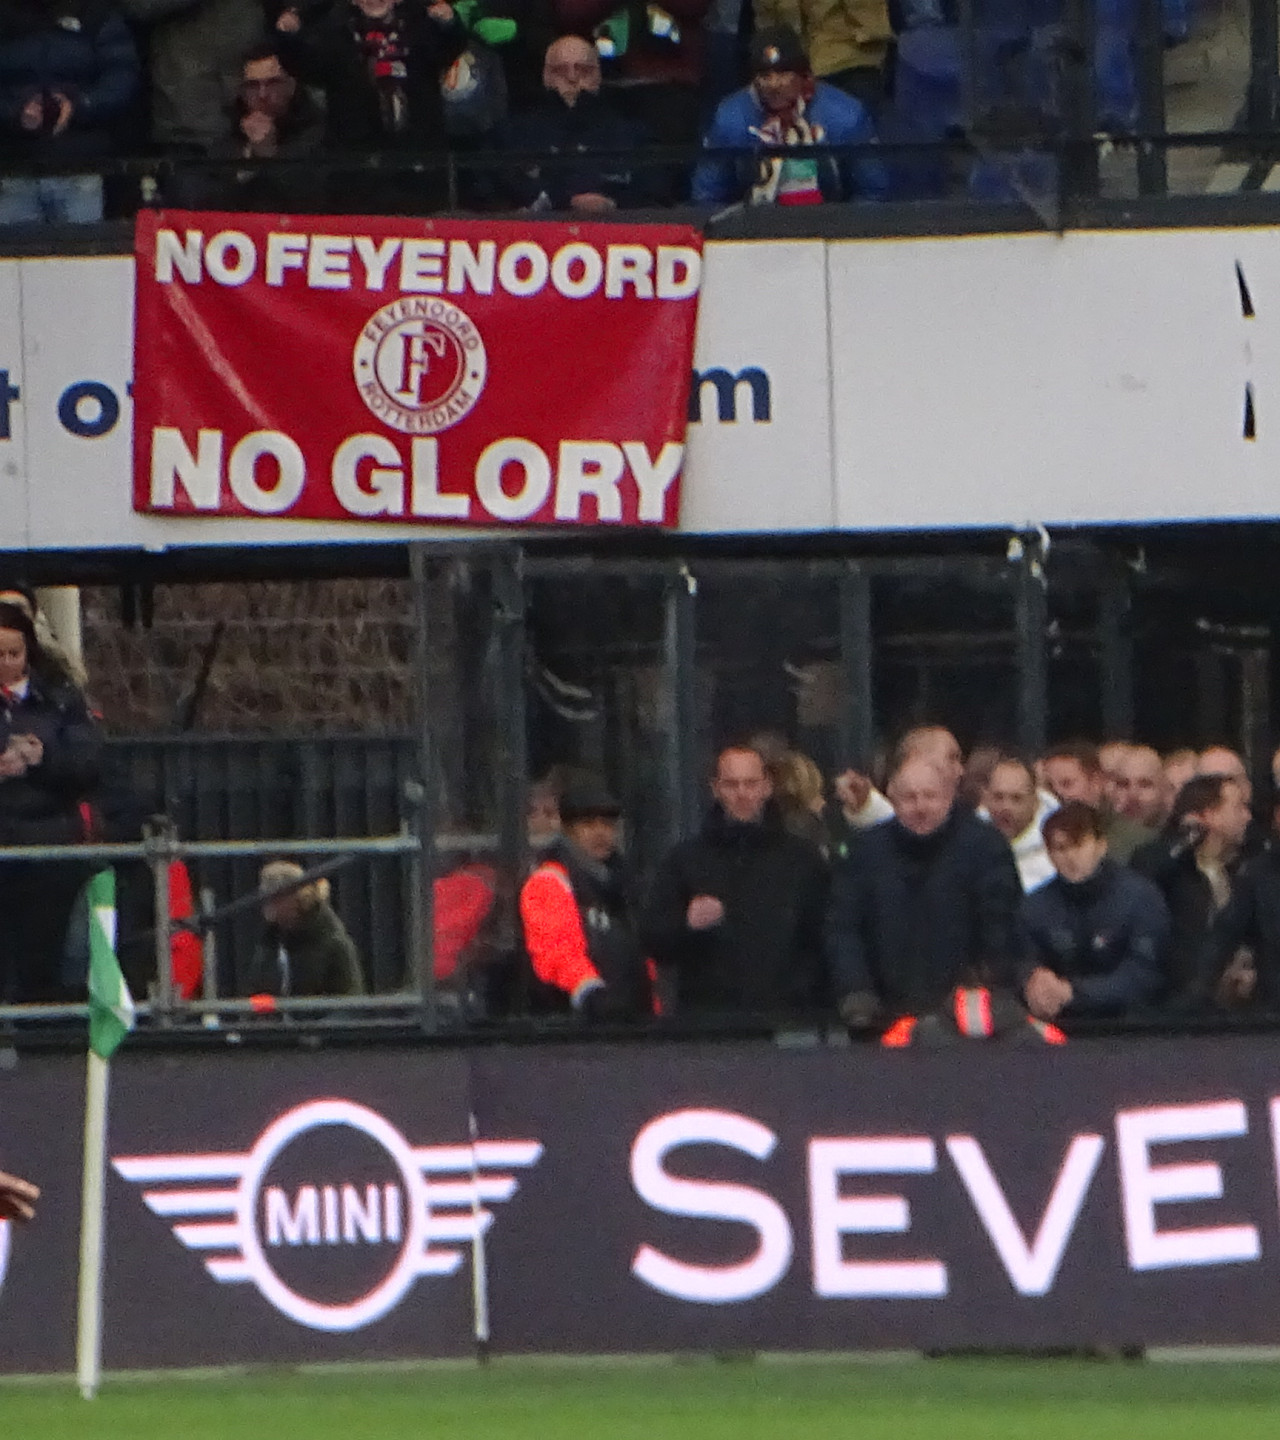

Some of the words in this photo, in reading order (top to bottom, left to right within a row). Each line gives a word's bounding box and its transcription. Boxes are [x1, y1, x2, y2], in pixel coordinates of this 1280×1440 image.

[155, 229, 257, 287] NO
[265, 232, 701, 299] FEYENOORD
[364, 299, 480, 351] FEYENOORD
[362, 382, 473, 430] ROTTERDAM
[150, 427, 307, 514] NO
[331, 432, 685, 523] GLORY
[263, 1182, 400, 1247] MINI
